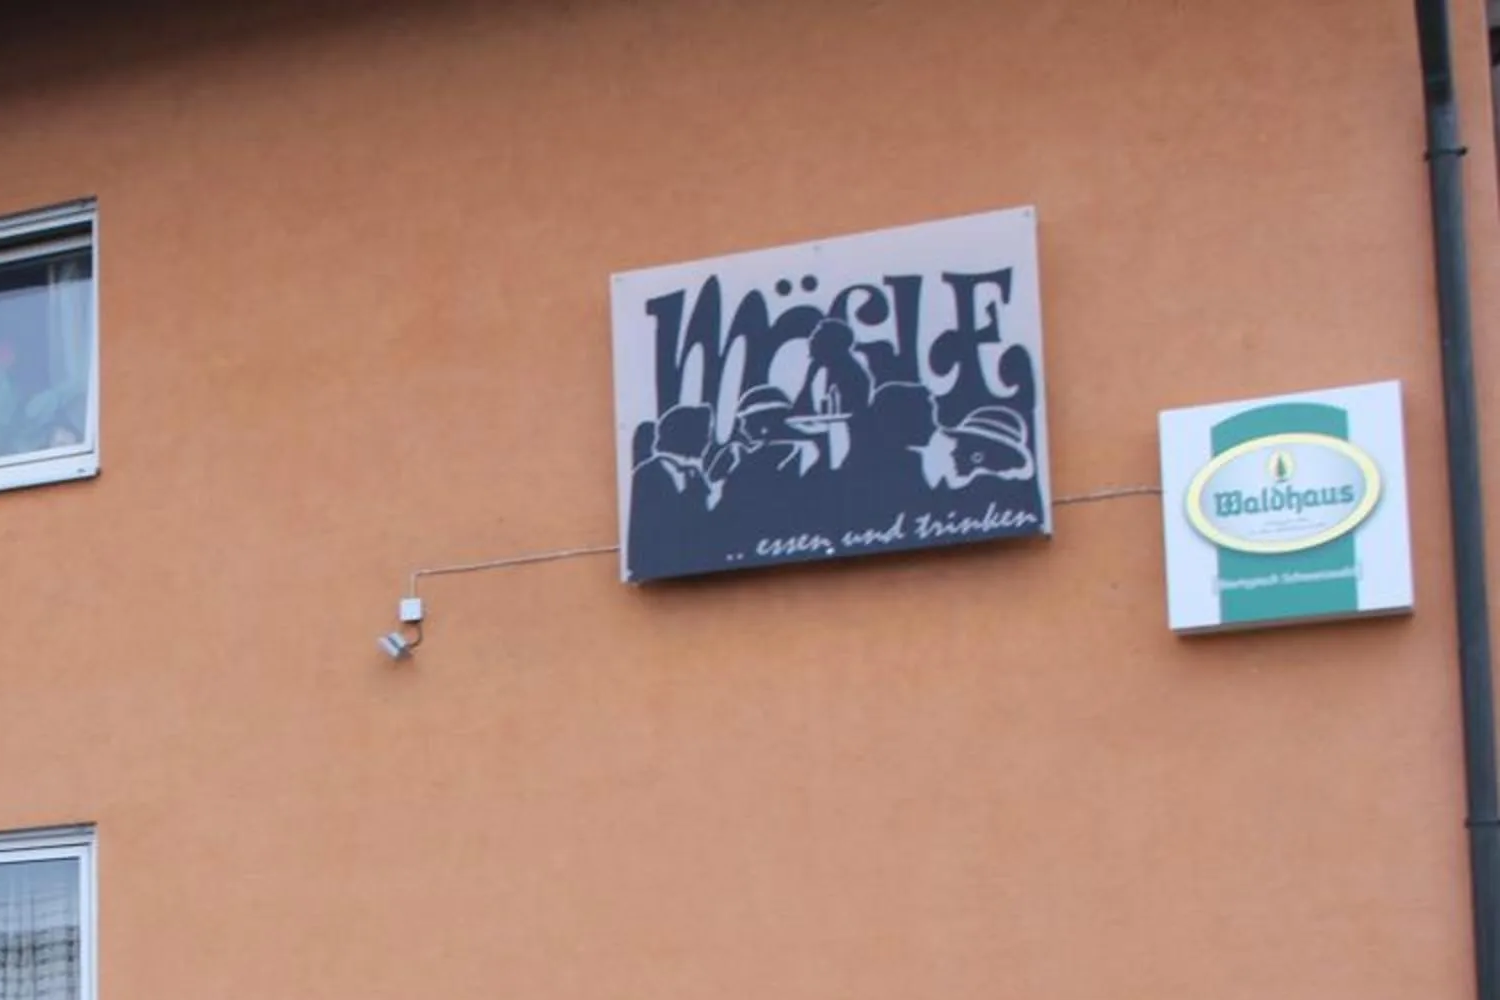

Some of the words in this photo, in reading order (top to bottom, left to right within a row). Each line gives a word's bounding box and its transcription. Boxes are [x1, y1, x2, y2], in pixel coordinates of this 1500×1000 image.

[1213, 484, 1356, 518] Waldhaus
[840, 511, 906, 547] und
[913, 501, 1039, 539] trinken
